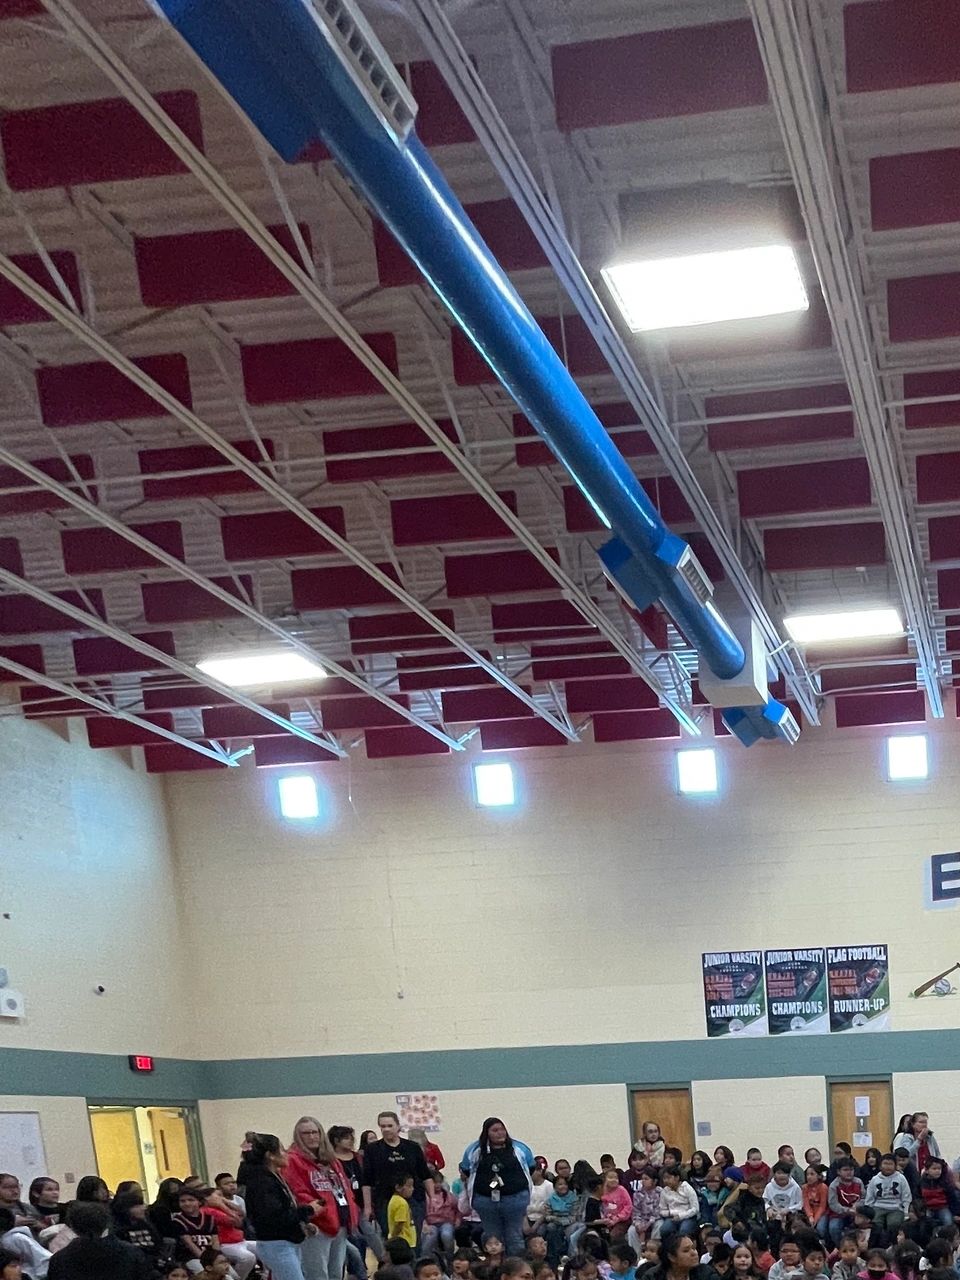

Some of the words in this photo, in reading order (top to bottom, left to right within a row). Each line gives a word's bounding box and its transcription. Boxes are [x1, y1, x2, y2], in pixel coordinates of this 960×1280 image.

[704, 953, 730, 968] JUNIOR
[731, 951, 761, 965] VARSITY
[766, 951, 793, 966] JUNIOR
[793, 949, 824, 963] VARSITY
[828, 948, 847, 964] FLAG
[848, 946, 887, 961] FOOTBALL
[710, 1003, 761, 1018] CHAMPIONS
[772, 1001, 823, 1015] CHAMPIONS
[833, 998, 885, 1013] RUNNER-UP
